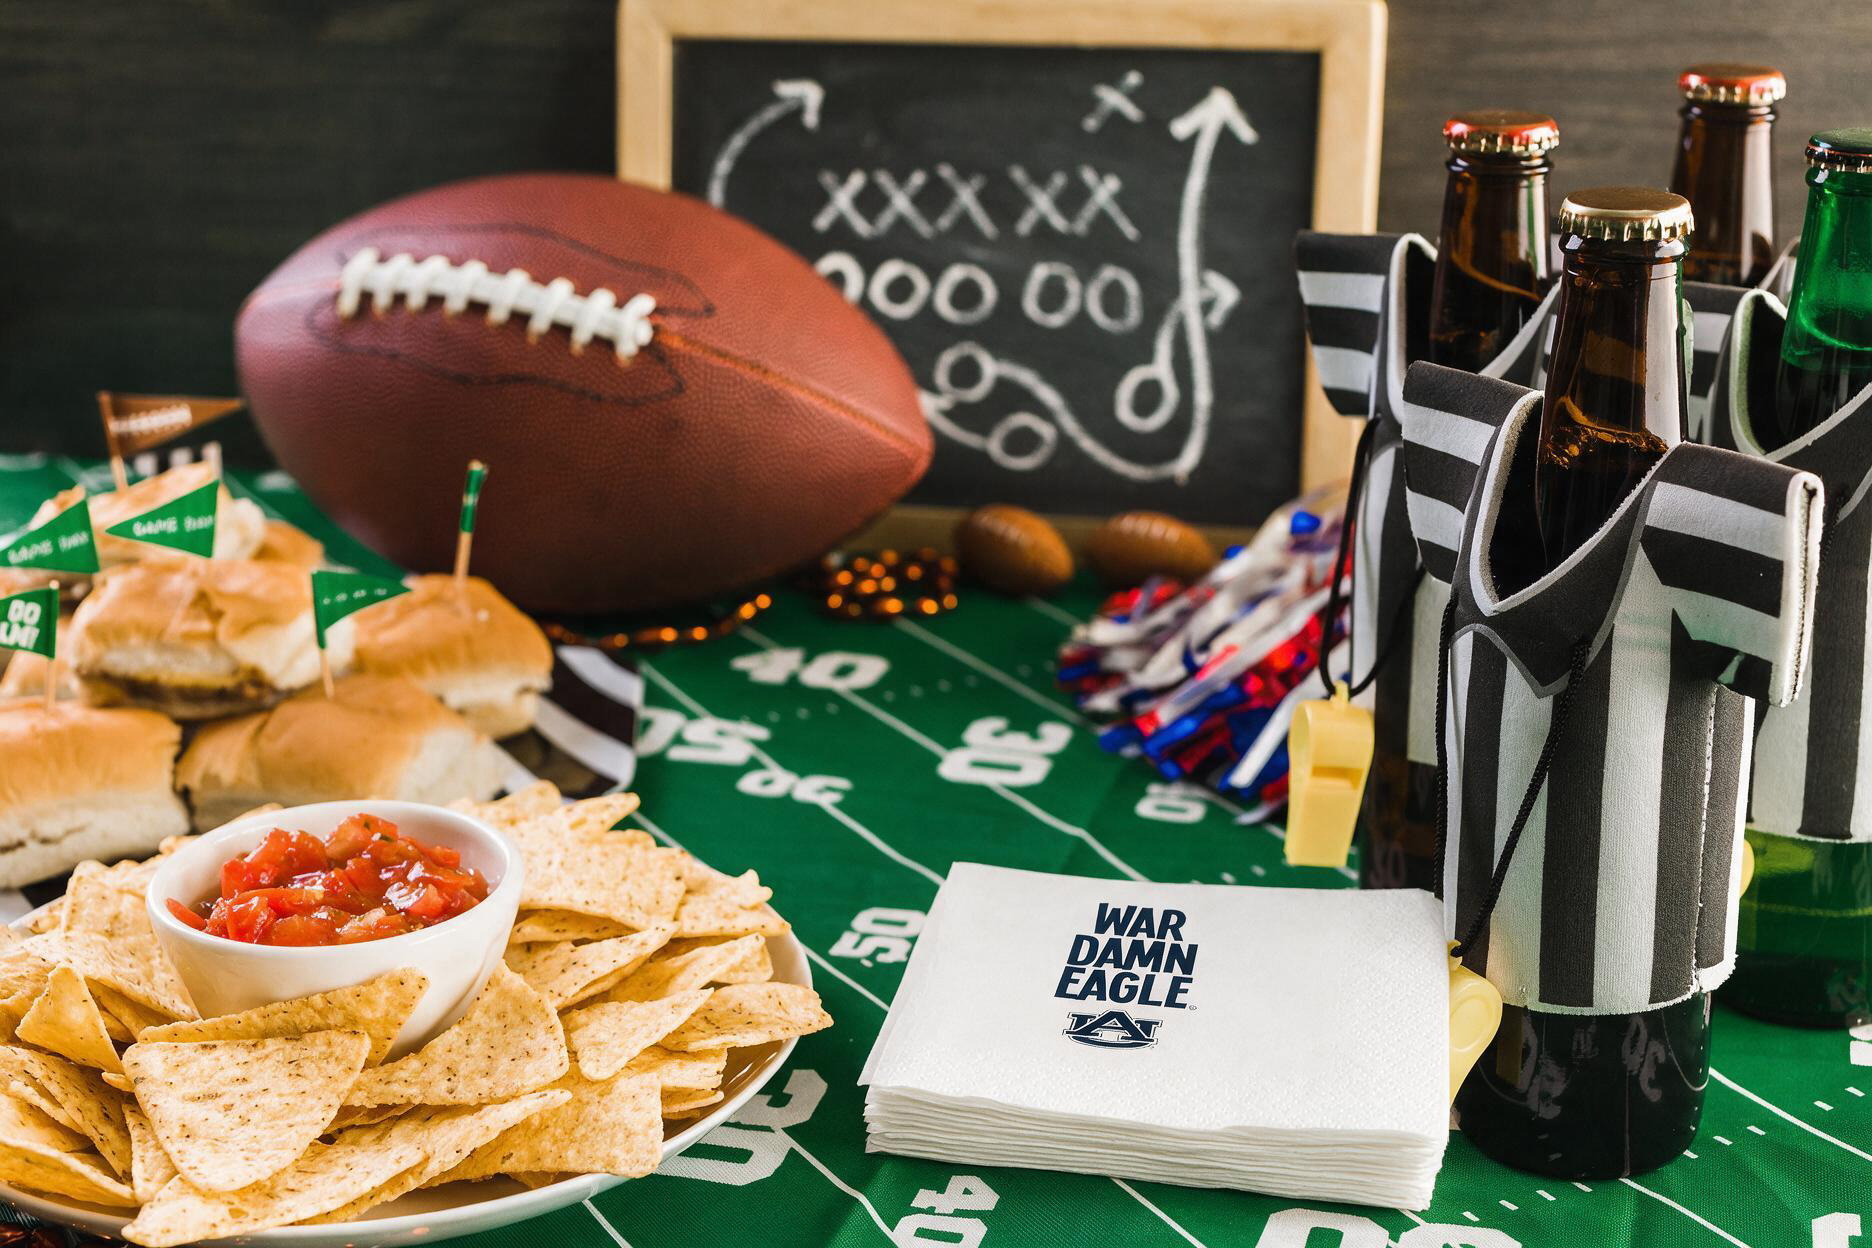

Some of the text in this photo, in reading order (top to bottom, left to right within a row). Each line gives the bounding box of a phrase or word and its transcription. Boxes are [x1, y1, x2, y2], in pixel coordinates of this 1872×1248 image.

[936, 716, 1074, 788] 30
[1094, 902, 1187, 941] WAR
[1066, 934, 1199, 975] DAMN
[1054, 966, 1194, 1010] EAGLE
[892, 1175, 1001, 1248] 40
